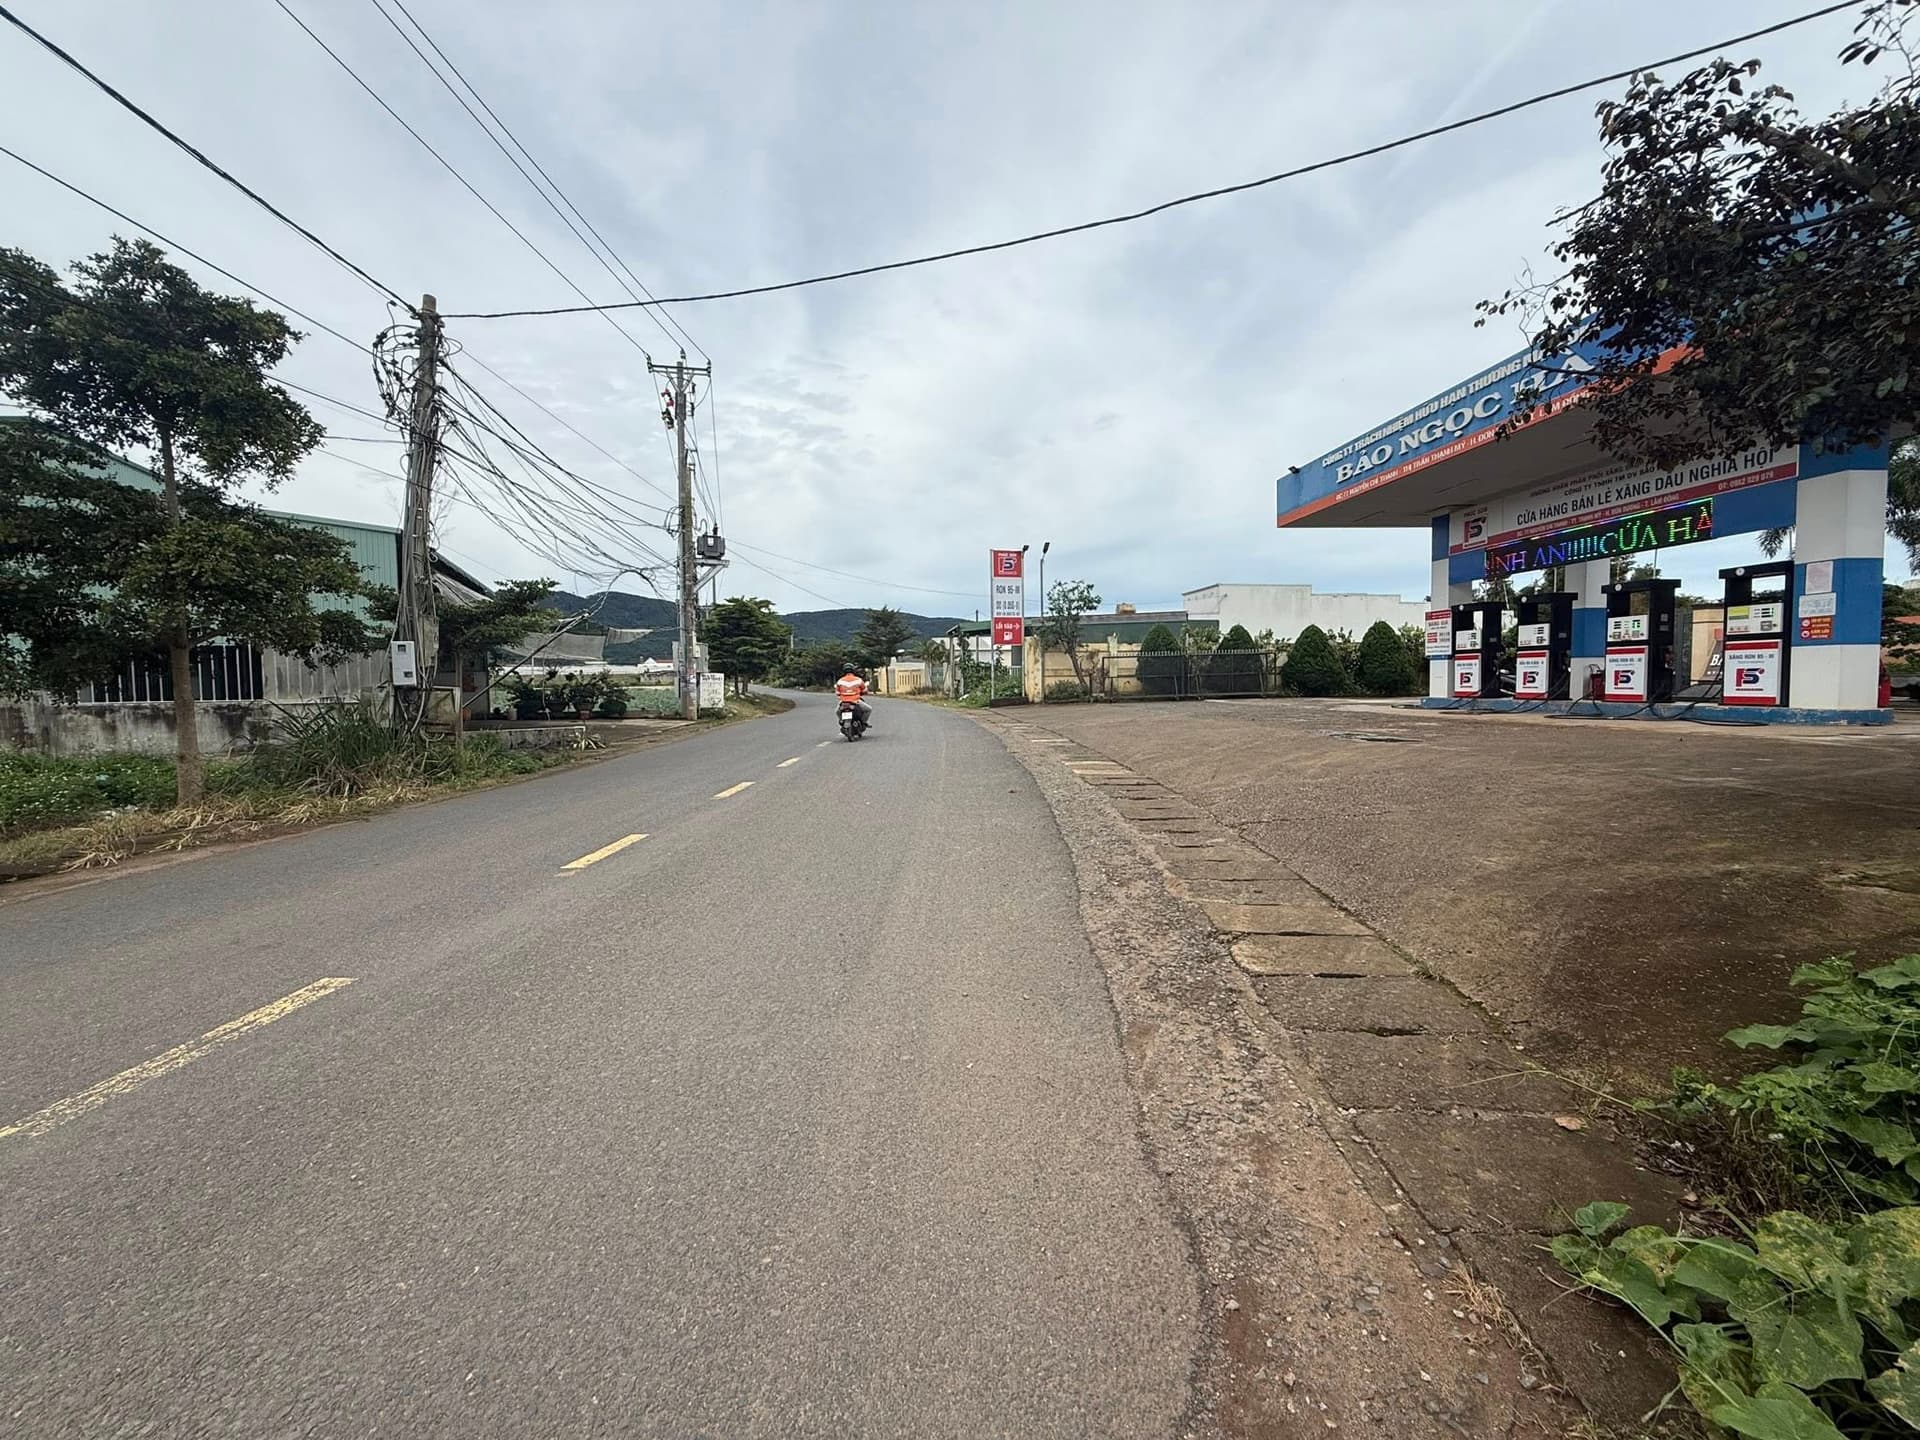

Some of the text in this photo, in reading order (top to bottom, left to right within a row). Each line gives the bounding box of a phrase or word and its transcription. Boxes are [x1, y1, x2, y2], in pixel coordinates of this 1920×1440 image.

[1336, 444, 1393, 483] BẢO
[1399, 391, 1502, 456] NGỌC
[1343, 444, 1354, 458] TY
[1355, 428, 1382, 451] TRÁCH
[1414, 398, 1440, 420] HỮU
[1440, 386, 1466, 408] HẠN
[1466, 358, 1522, 395] THƯƠNG
[1413, 455, 1431, 469] TRẤN
[1517, 508, 1537, 525] CỬA
[1539, 502, 1568, 521] HÀNG
[1571, 494, 1594, 512] BÁN
[1597, 487, 1612, 505] LẺ
[1615, 479, 1650, 501] XĂNG
[1743, 446, 1774, 470] HỘI
